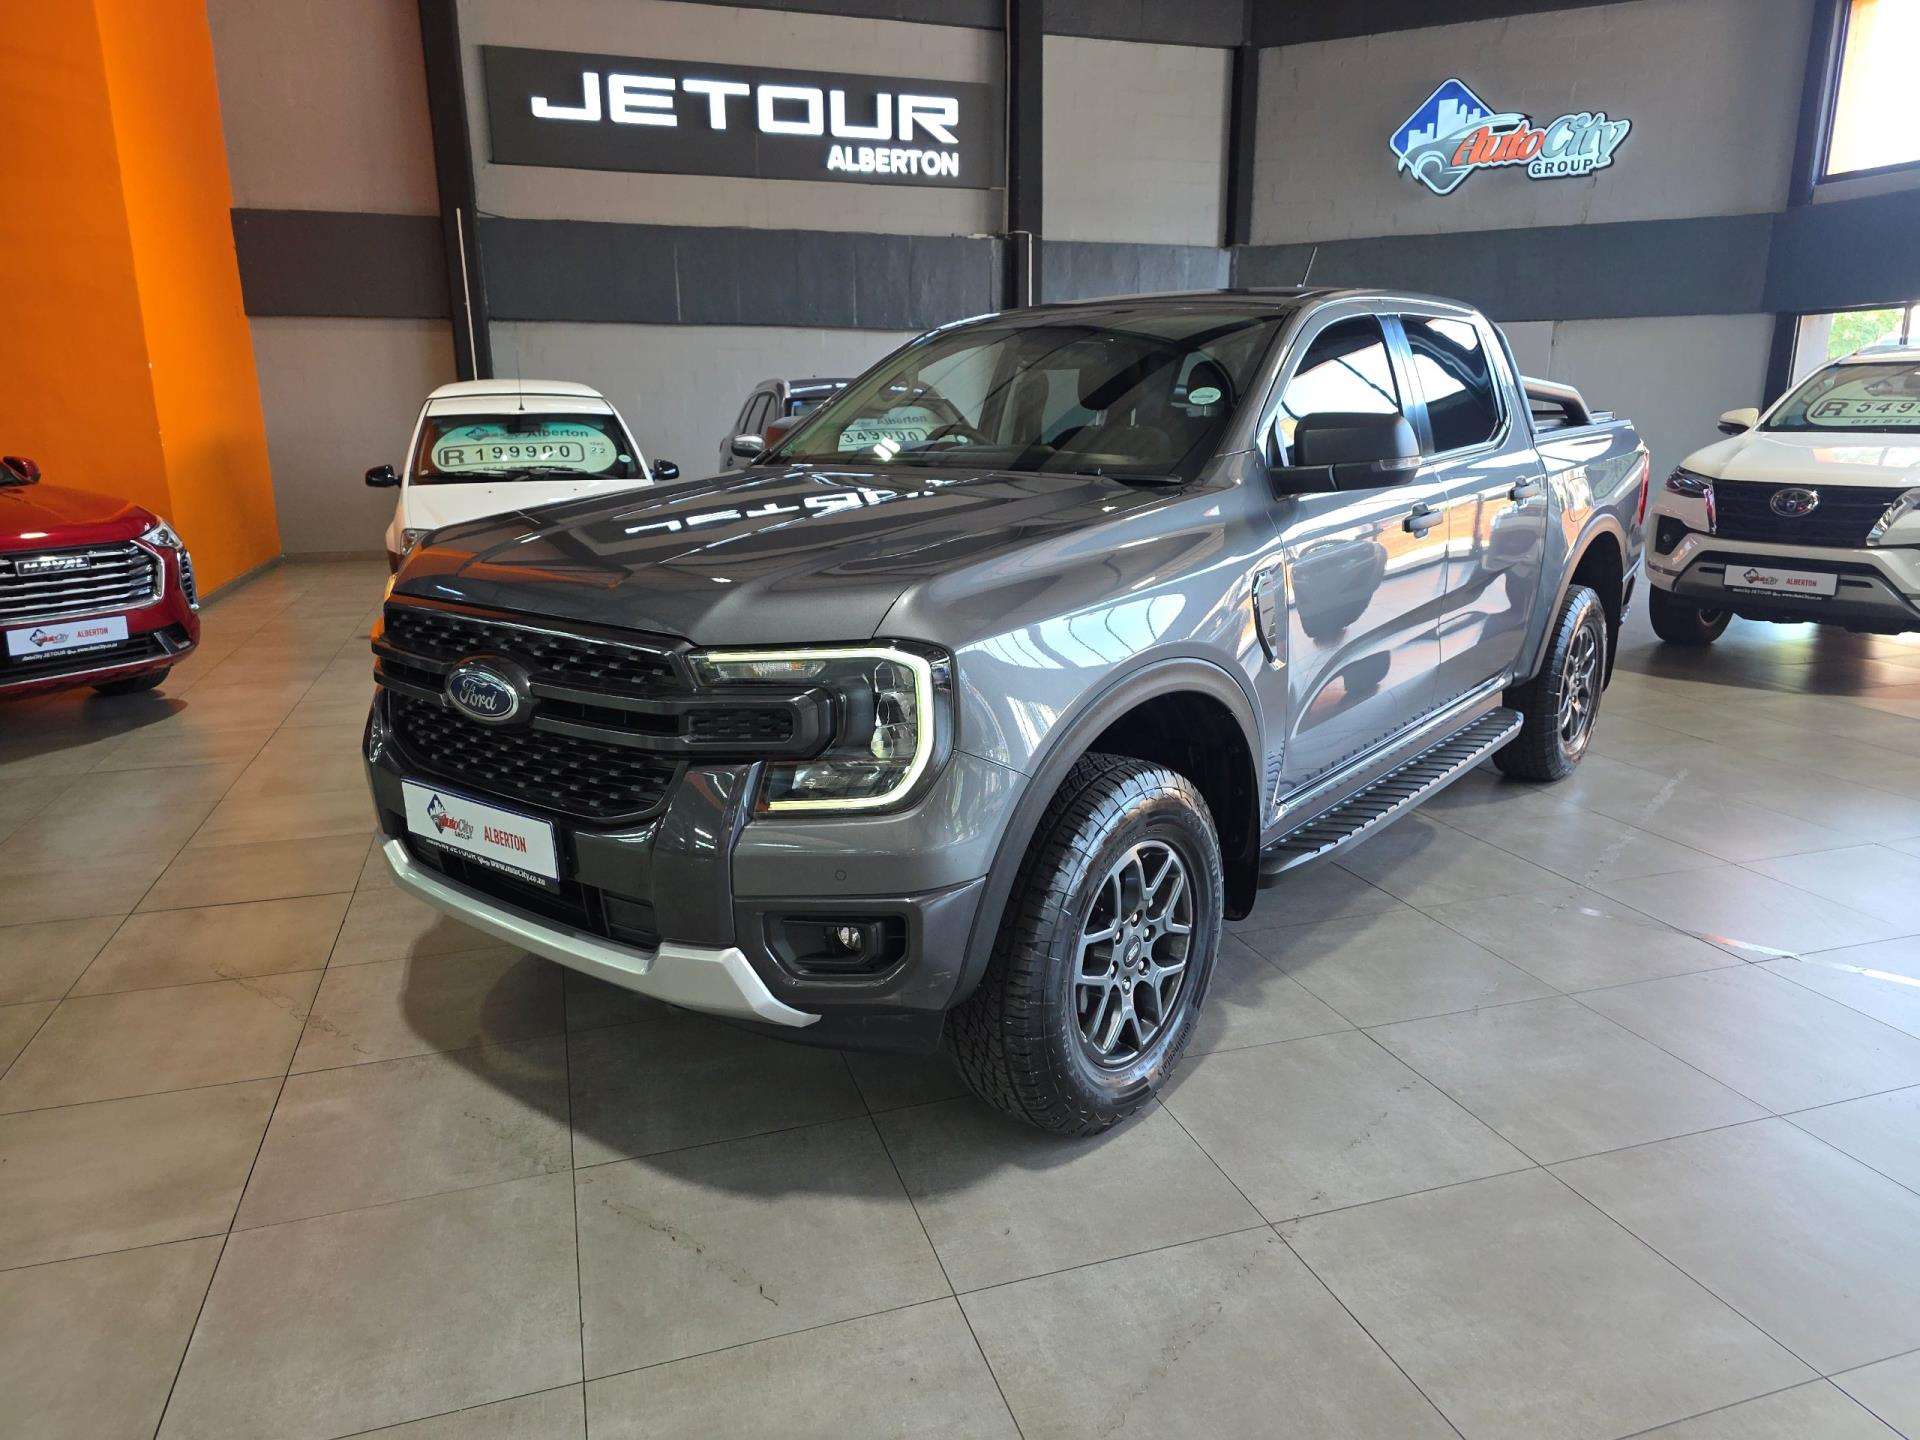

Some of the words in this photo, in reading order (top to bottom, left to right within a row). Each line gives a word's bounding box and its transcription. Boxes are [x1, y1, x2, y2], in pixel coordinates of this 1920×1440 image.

[531, 72, 959, 144] JETOUR
[826, 144, 959, 177] ALBERTON
[1531, 158, 1594, 175] GROUP
[1817, 402, 1849, 416] R
[1856, 402, 1920, 413] 549
[527, 429, 589, 438] Alberton
[444, 449, 464, 465] R
[460, 678, 498, 711] Ford
[483, 825, 527, 853] ALBERTON
